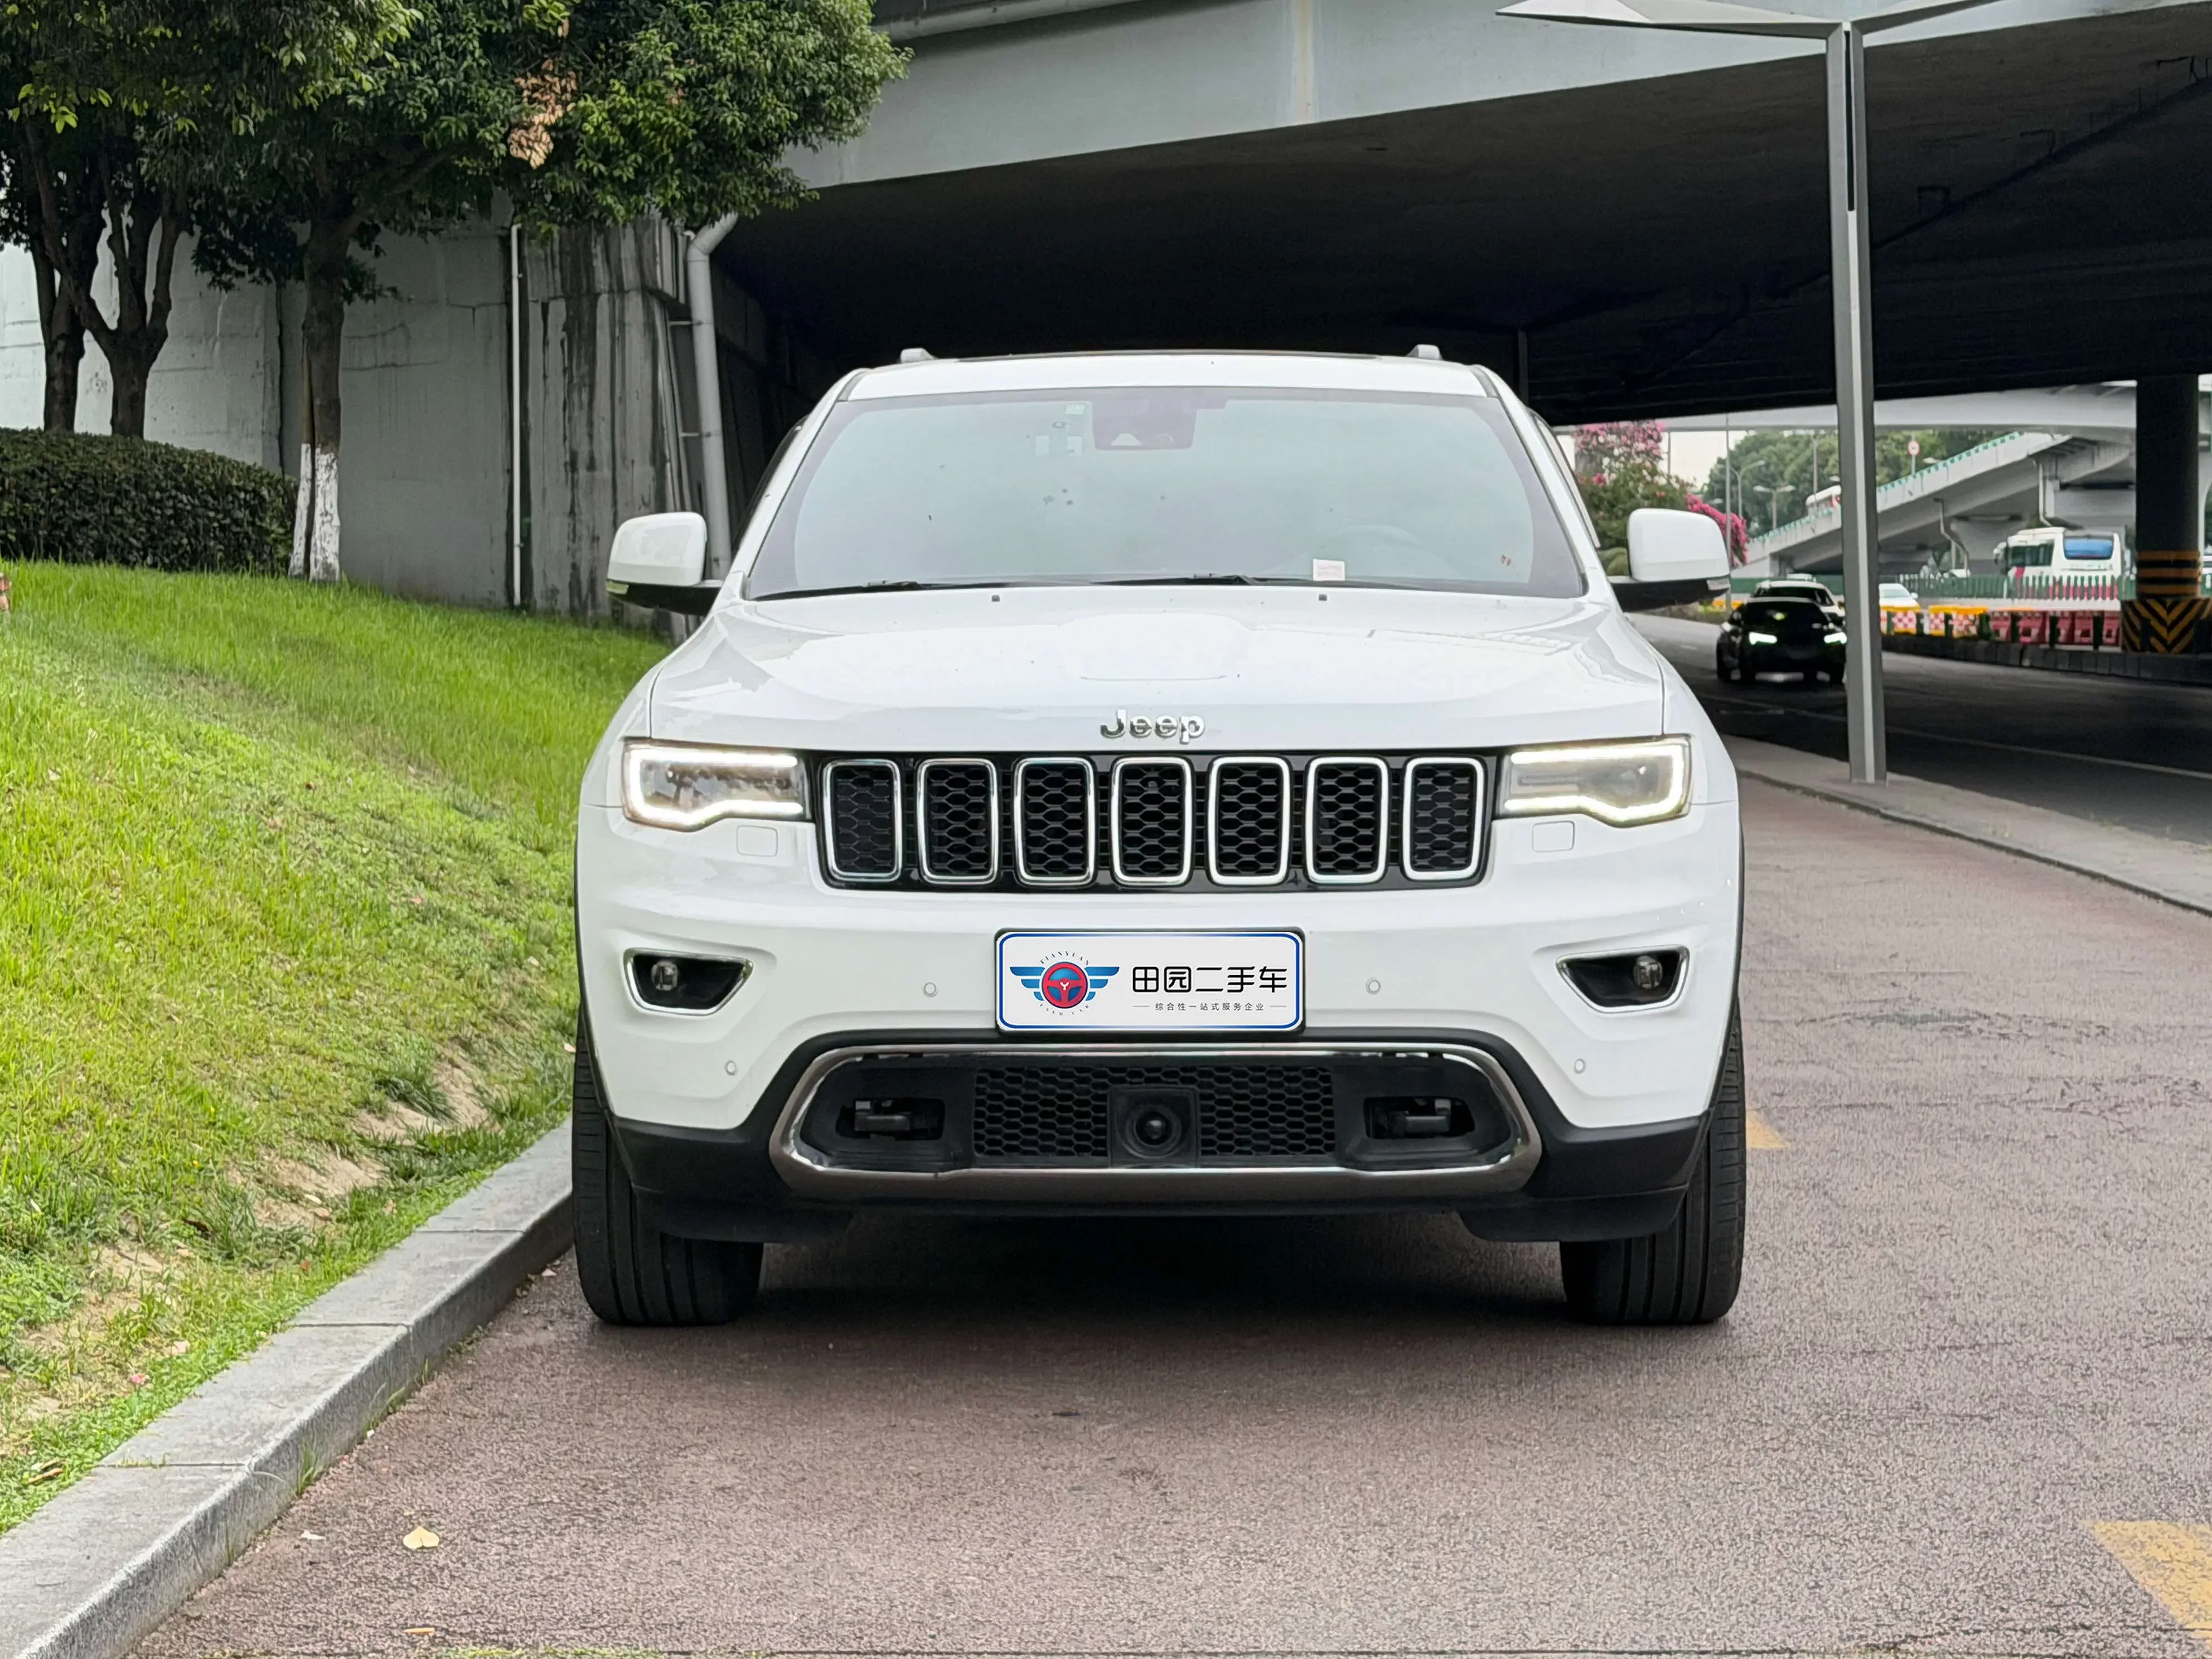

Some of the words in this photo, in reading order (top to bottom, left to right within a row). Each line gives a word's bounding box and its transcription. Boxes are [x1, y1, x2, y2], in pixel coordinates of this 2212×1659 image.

[1100, 709, 1205, 745] Jeep
[1132, 966, 1287, 993] 田园二手车
[1155, 1002, 1264, 1011] 综合性一站式服务企业
